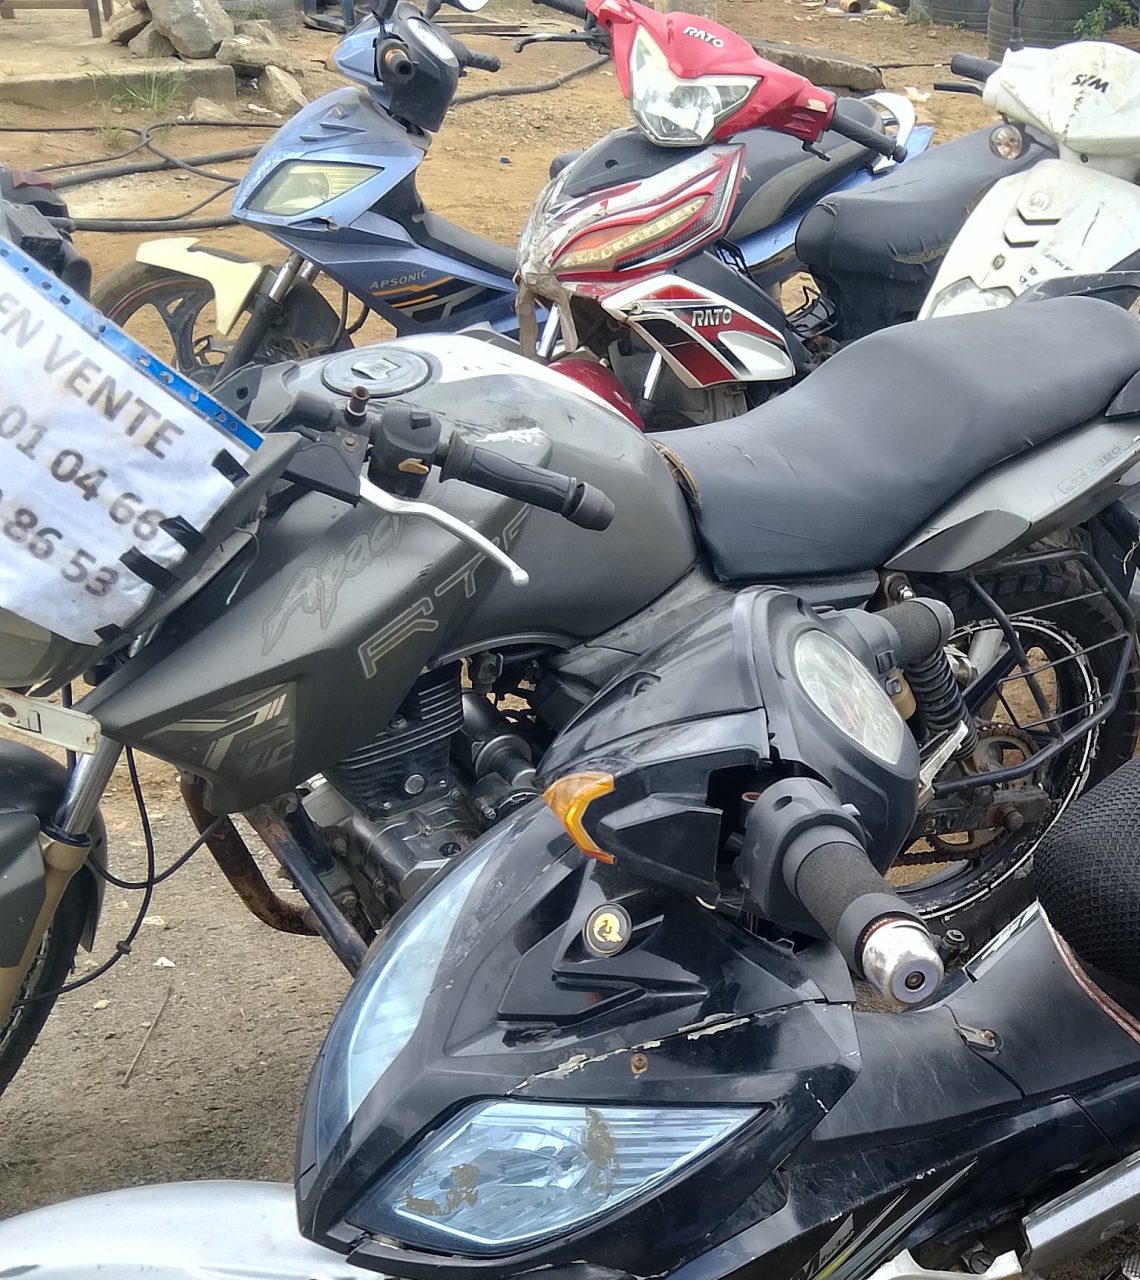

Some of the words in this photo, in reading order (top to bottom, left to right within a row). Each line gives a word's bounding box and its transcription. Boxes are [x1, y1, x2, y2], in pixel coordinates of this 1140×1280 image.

[683, 26, 725, 48] RATO
[369, 269, 428, 290] APSONIC
[691, 308, 732, 328] RATO
[43, 333, 185, 460] VENTE
[0, 405, 48, 460] 01
[51, 448, 108, 502] 04
[3, 507, 64, 560] 86
[61, 548, 119, 597] 53
